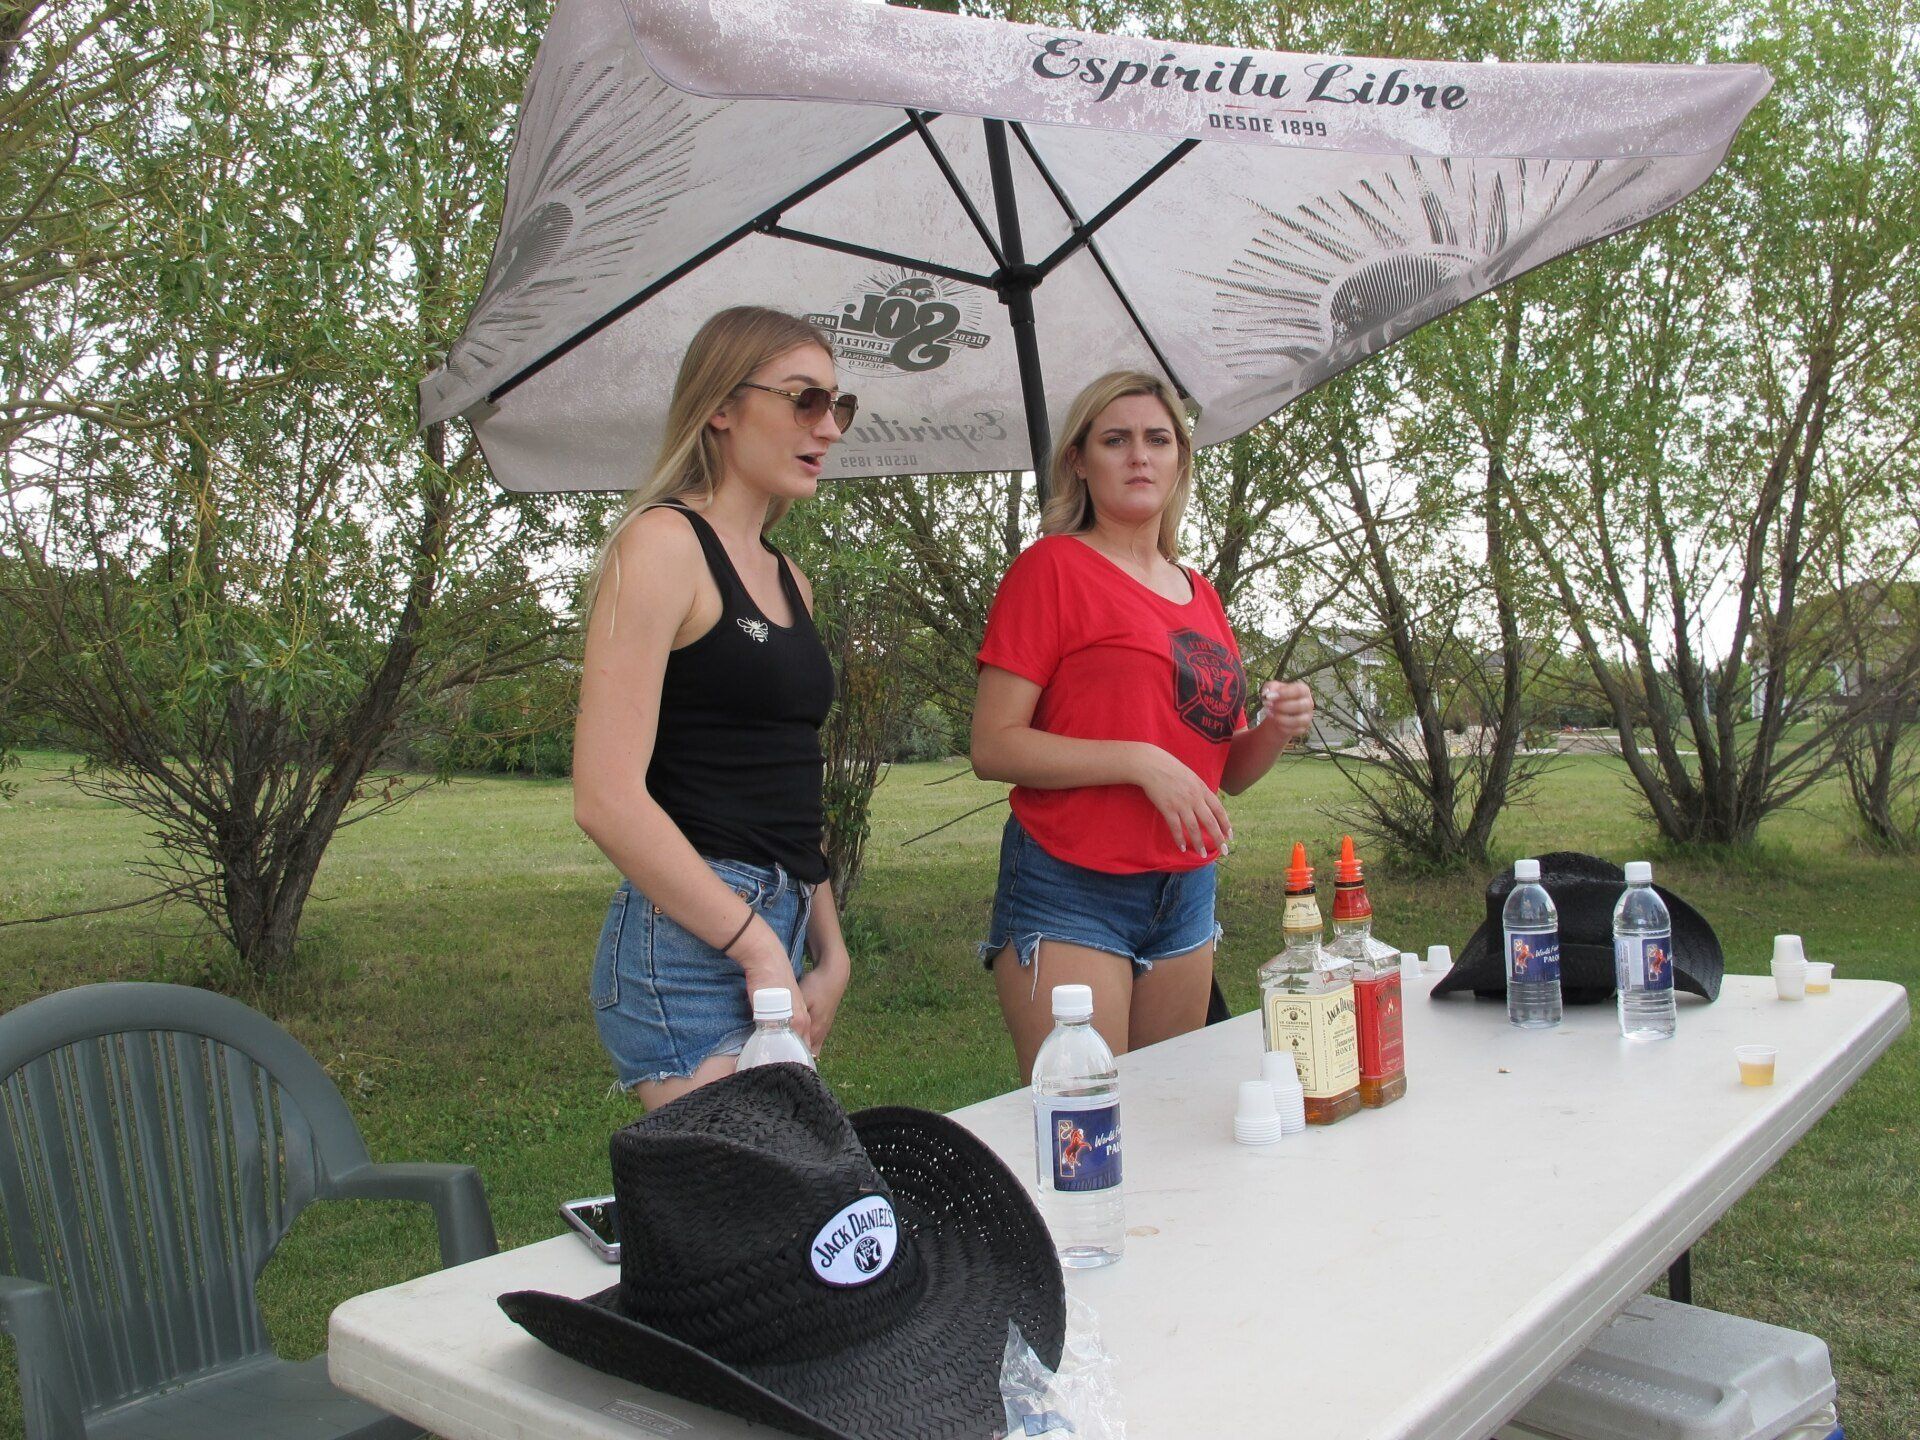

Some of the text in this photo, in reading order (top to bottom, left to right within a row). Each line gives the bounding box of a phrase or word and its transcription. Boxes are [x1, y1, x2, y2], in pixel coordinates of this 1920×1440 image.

[1027, 32, 1469, 111] Espíritu Libre
[1209, 113, 1328, 138] DESDE 1899
[814, 1204, 893, 1268] JACK DANIEL'S
